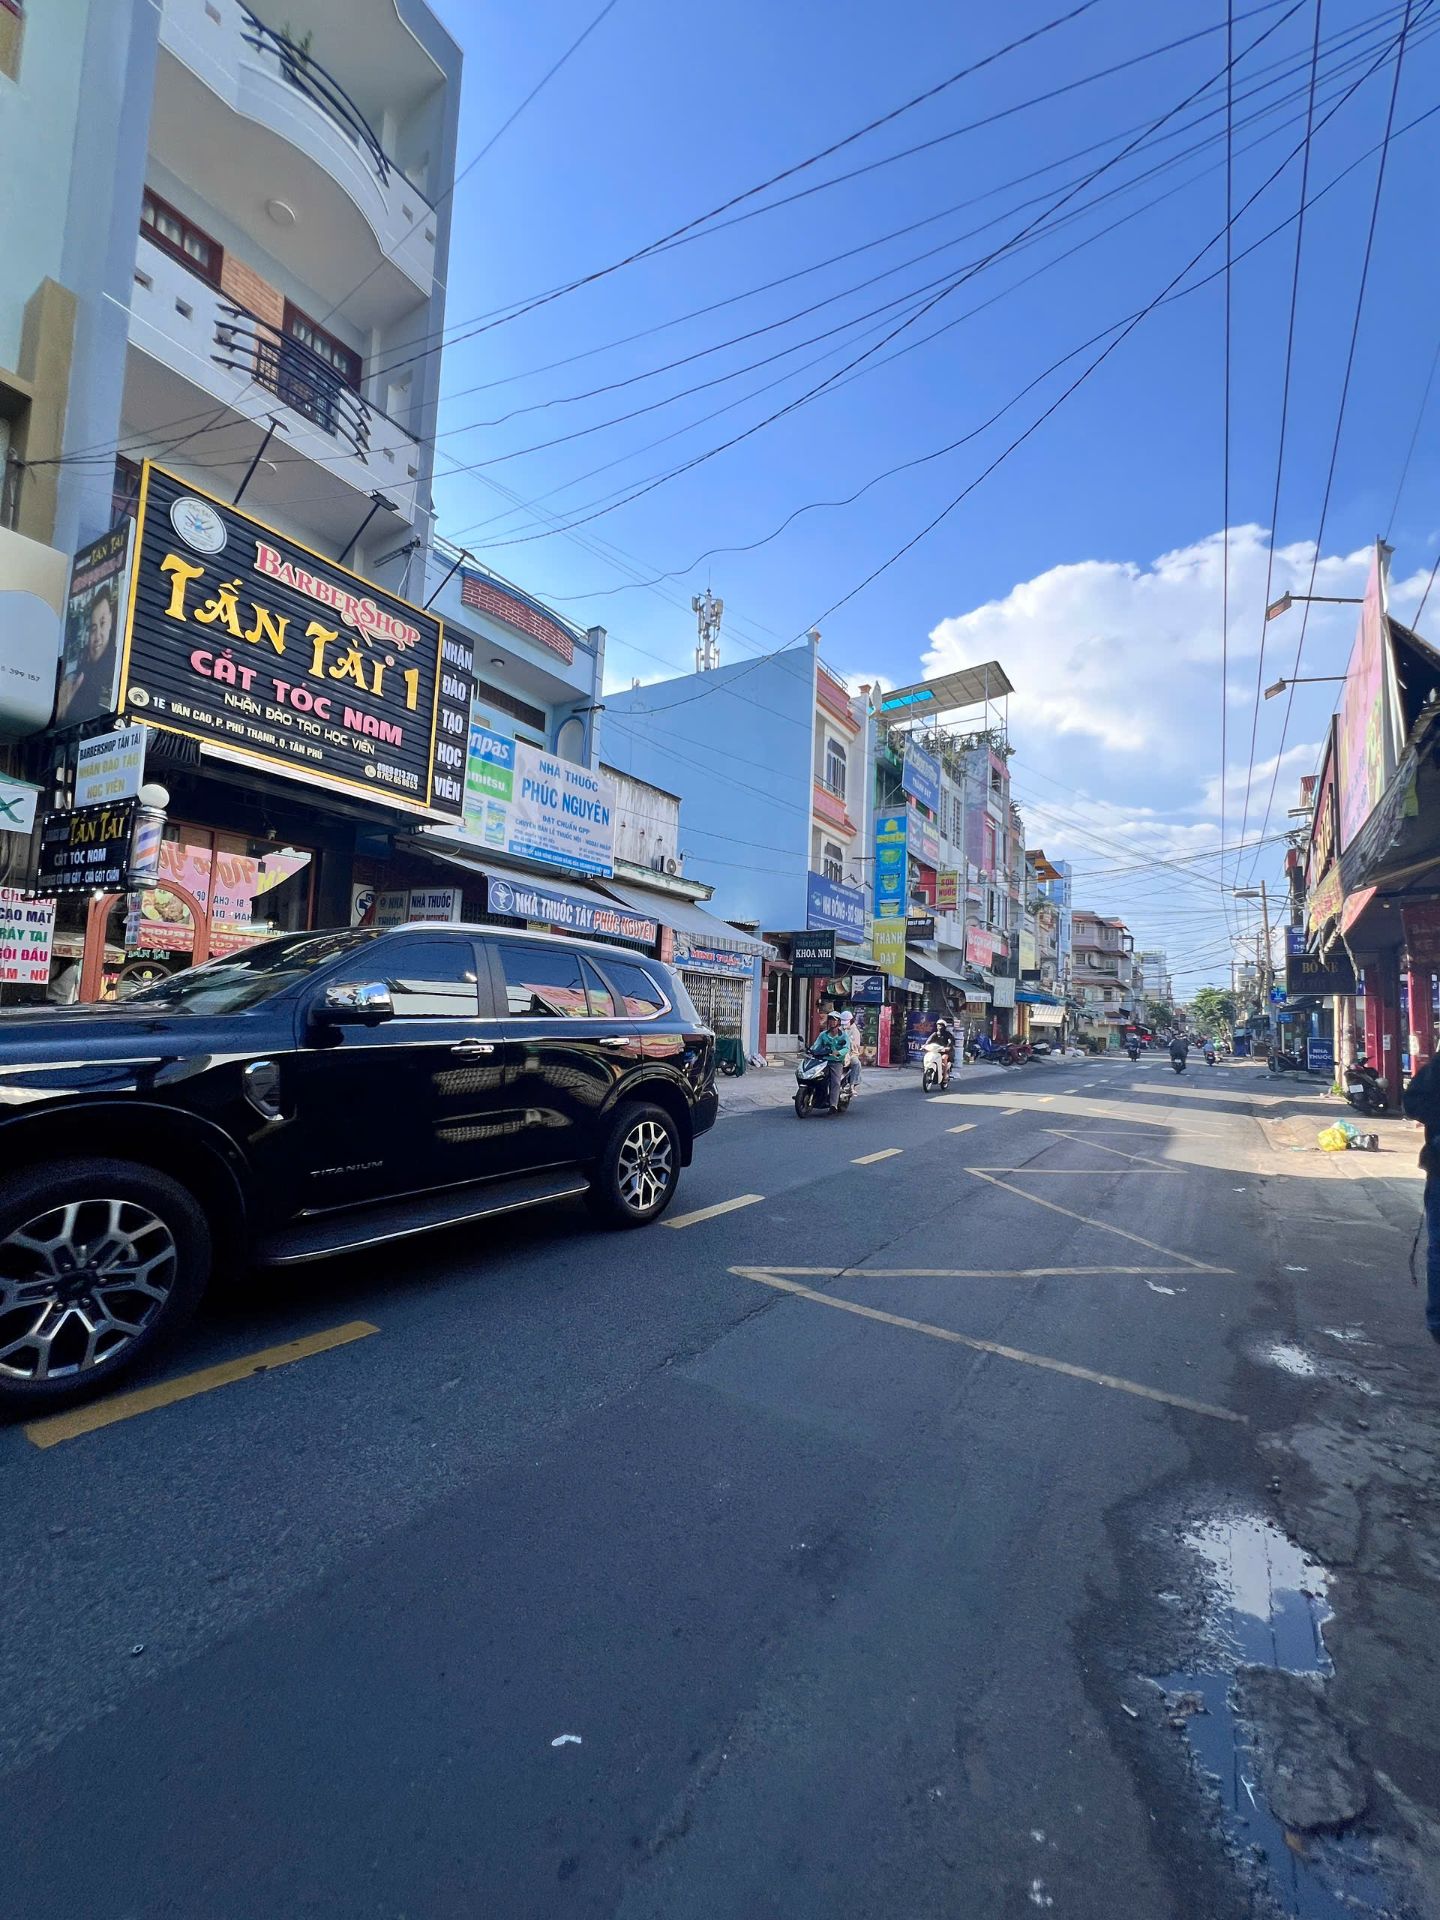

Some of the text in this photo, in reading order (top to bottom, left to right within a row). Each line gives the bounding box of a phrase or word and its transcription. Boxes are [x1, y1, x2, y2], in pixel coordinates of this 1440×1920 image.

[160, 553, 419, 711] TẤN TÀI 1
[442, 639, 473, 671] NHẬN
[191, 648, 403, 746] CẮT TÓC NAM
[442, 674, 467, 702] ĐÀO
[152, 697, 166, 710] 1E
[226, 720, 244, 734] PHÚ
[289, 741, 305, 755] TÂN
[307, 748, 323, 760] PHÚ
[224, 693, 375, 756] NHẬN ĐÀO TẠO HỌC VIÊN
[442, 708, 464, 734] TẠO
[437, 741, 462, 770] HỌC
[434, 776, 461, 802] VIÊN
[540, 759, 599, 792] NHÀ THUỐC
[522, 778, 610, 826] PHÚC NGUYÊN
[87, 848, 107, 863] NAM
[411, 891, 451, 908] NHÀ THUỐC
[0, 908, 53, 925] CẠO MẶT
[515, 892, 538, 916] NHÀ
[541, 897, 573, 924] THUỐC
[575, 905, 592, 928] TÂY
[593, 910, 620, 935] PHÚC
[621, 916, 656, 943] NGUYÊN
[0, 927, 48, 942] RÁY TAI
[796, 949, 832, 958] KHOA NHI
[310, 1160, 383, 1178] TITANIUM
